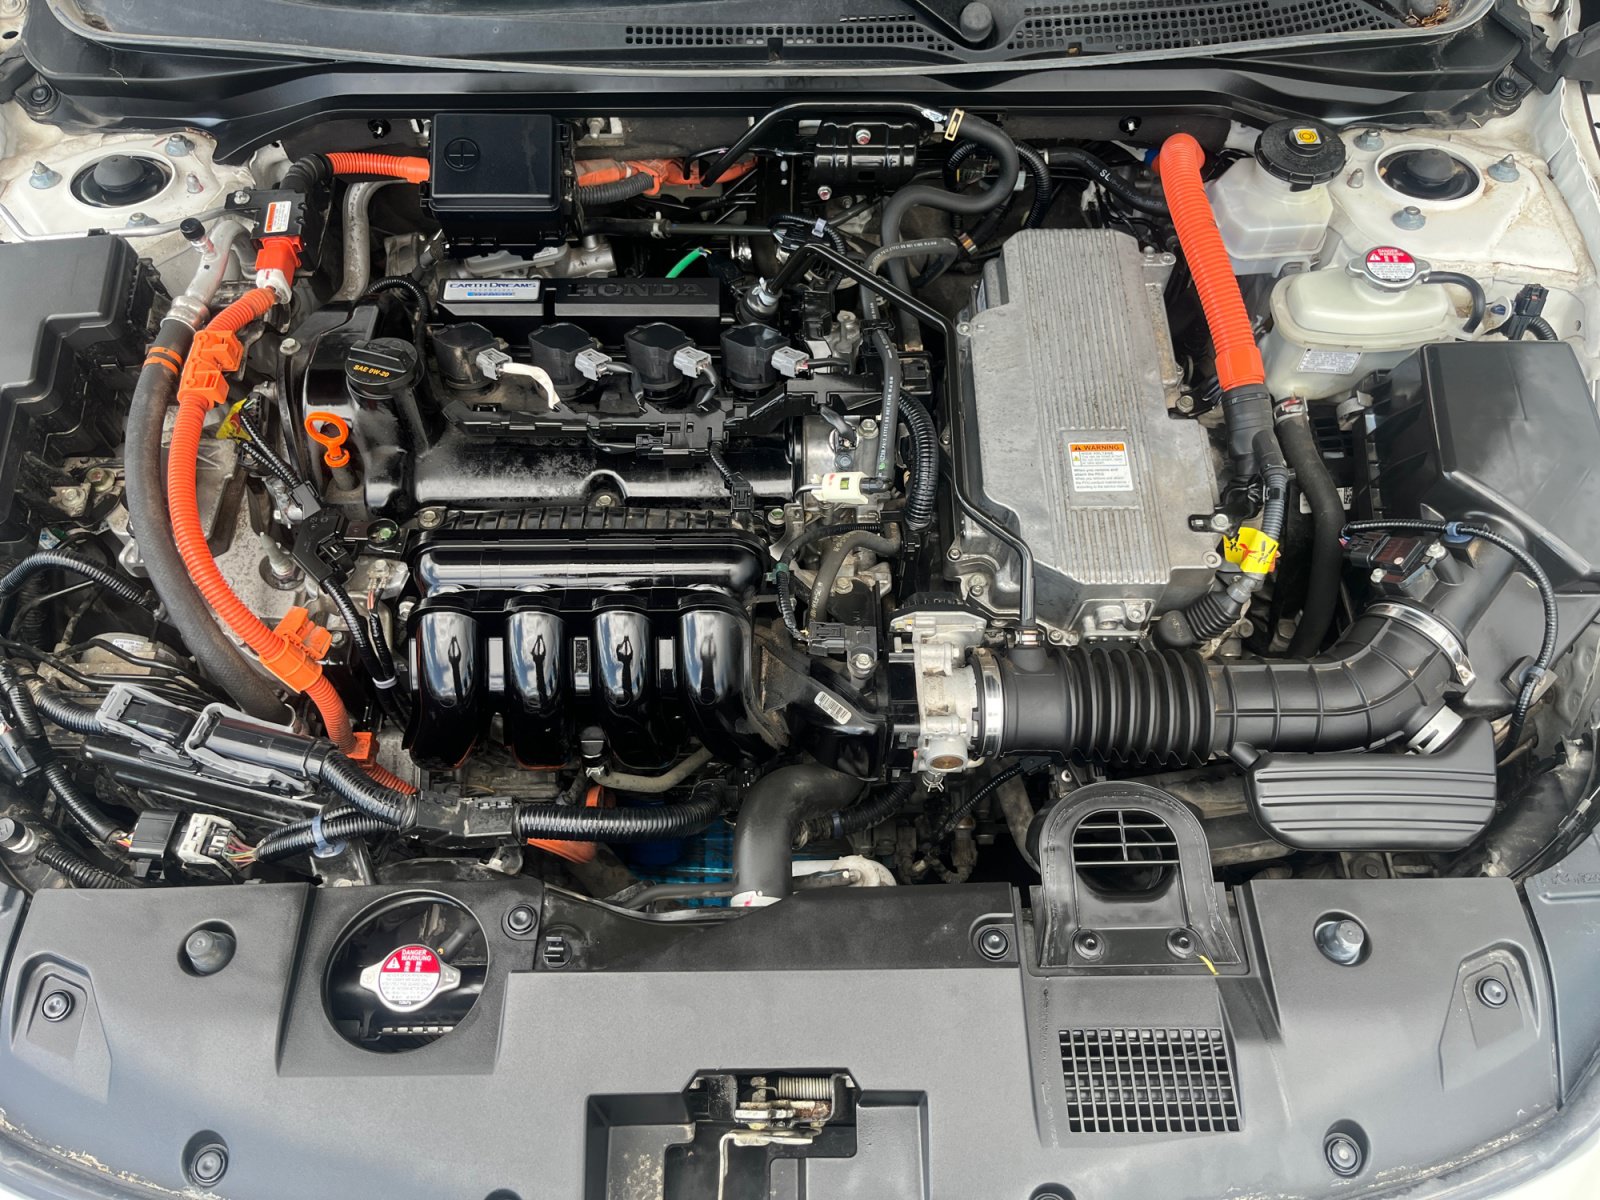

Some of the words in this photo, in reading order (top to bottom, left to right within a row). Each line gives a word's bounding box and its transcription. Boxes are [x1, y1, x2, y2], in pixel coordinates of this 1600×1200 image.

[1100, 169, 1111, 182] SL
[567, 283, 708, 297] HONDA
[353, 364, 369, 373] SAE
[368, 368, 390, 378] 0W-20
